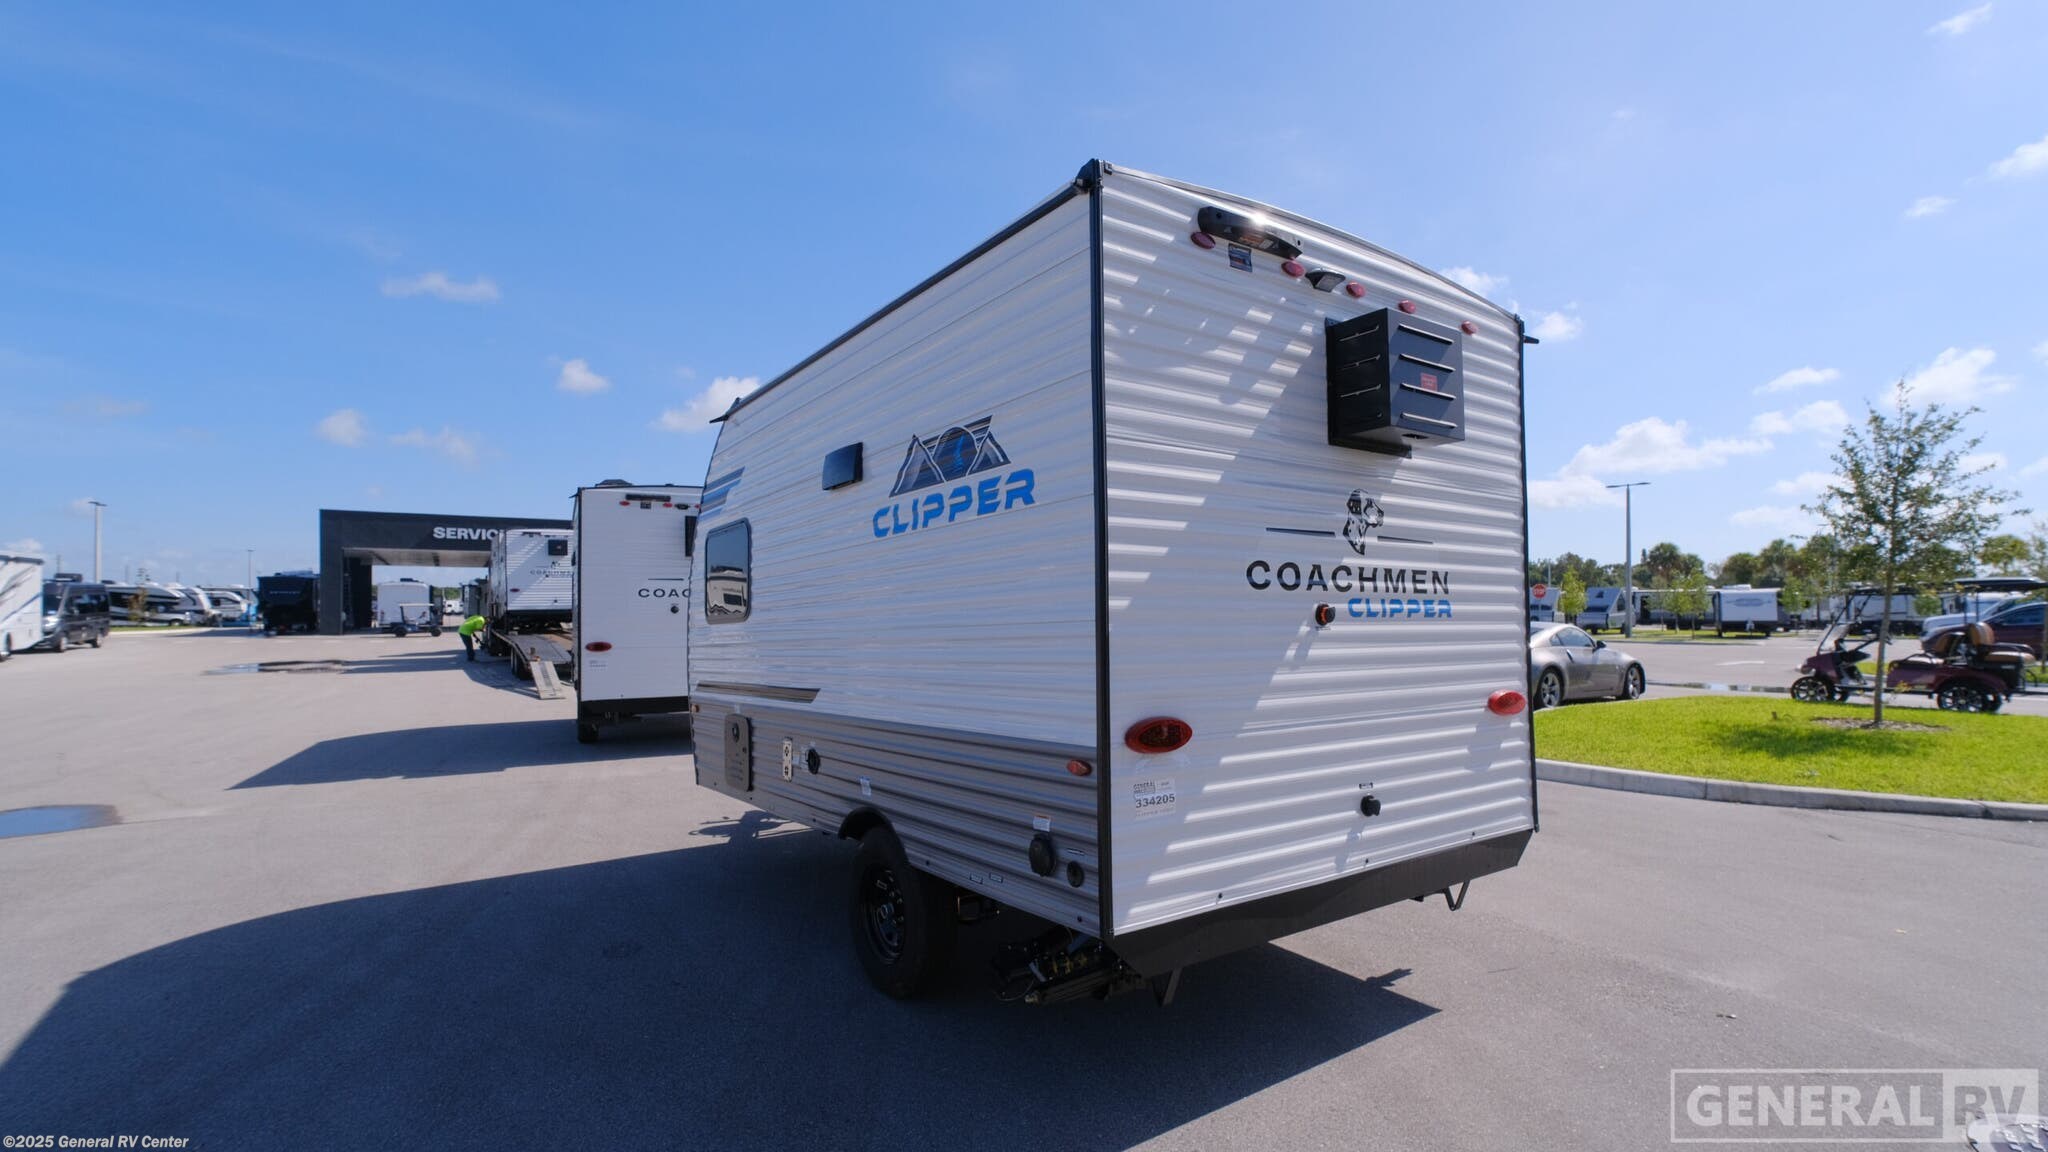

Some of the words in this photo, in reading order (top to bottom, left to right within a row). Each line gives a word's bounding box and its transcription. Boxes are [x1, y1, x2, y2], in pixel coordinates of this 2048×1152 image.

[872, 468, 1035, 538] CLIPPER
[433, 526, 504, 540] SERVIC
[1246, 560, 1450, 595] COACHMEN
[1348, 598, 1452, 618] CLIPPER
[1135, 793, 1175, 809] 334205
